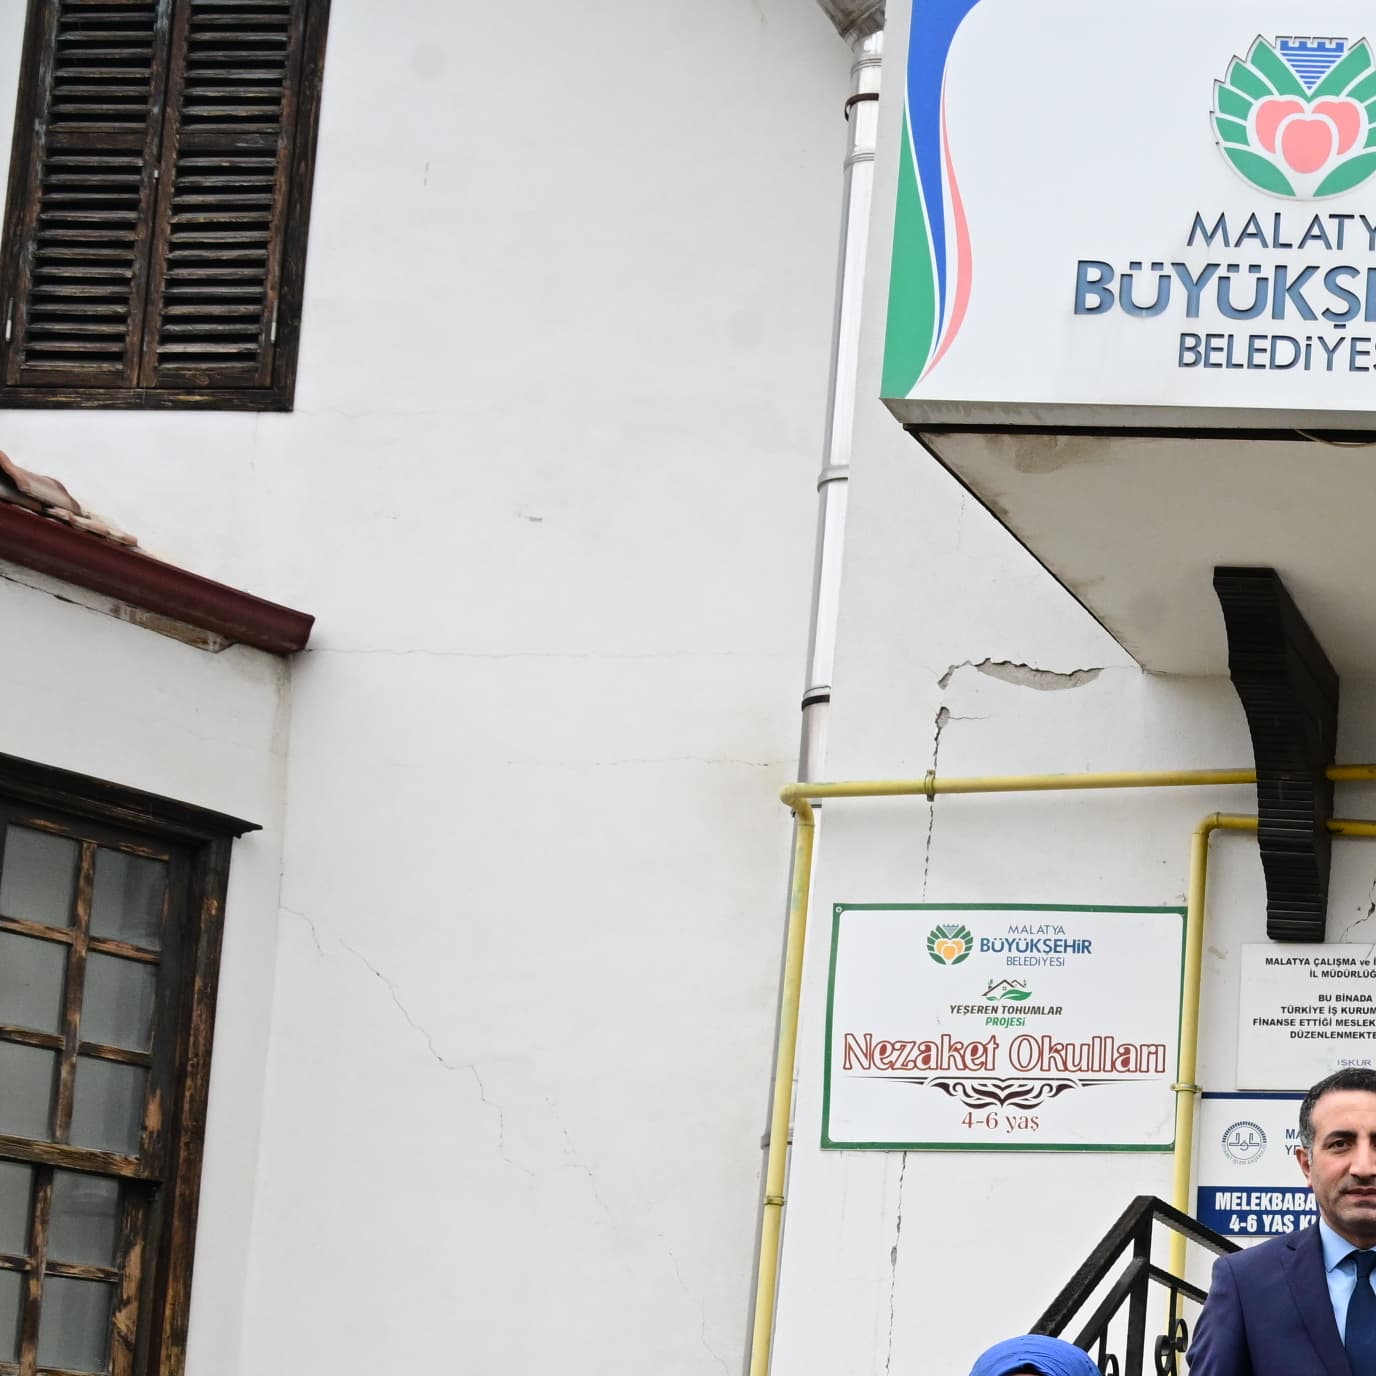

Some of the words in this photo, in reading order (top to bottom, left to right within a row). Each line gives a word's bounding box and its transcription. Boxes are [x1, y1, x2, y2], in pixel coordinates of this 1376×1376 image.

[1008, 925, 1066, 935] MALATYA
[1265, 958, 1310, 966] MALATYA
[1313, 958, 1357, 968] ÇALIŞMA
[1309, 969, 1319, 978] İL
[1318, 994, 1332, 1002] BU
[1335, 993, 1373, 1003] BİNADA
[950, 1005, 998, 1016] YEŞEREN
[1001, 1005, 1063, 1016] TOHUMLAR
[1281, 1005, 1325, 1015] TÜRKİYE
[1328, 1006, 1338, 1016] İŞ
[1253, 1017, 1296, 1027] FİNANSE
[1299, 1017, 1332, 1027] ETTİĞİ
[842, 1032, 1000, 1072] Nezaket
[1008, 1034, 1166, 1073] Okulları
[961, 1111, 999, 1130] 4-6
[1005, 1112, 1040, 1134] yaş
[1215, 1192, 1317, 1211] MELEKBABA
[1230, 1215, 1257, 1232] 4-6
